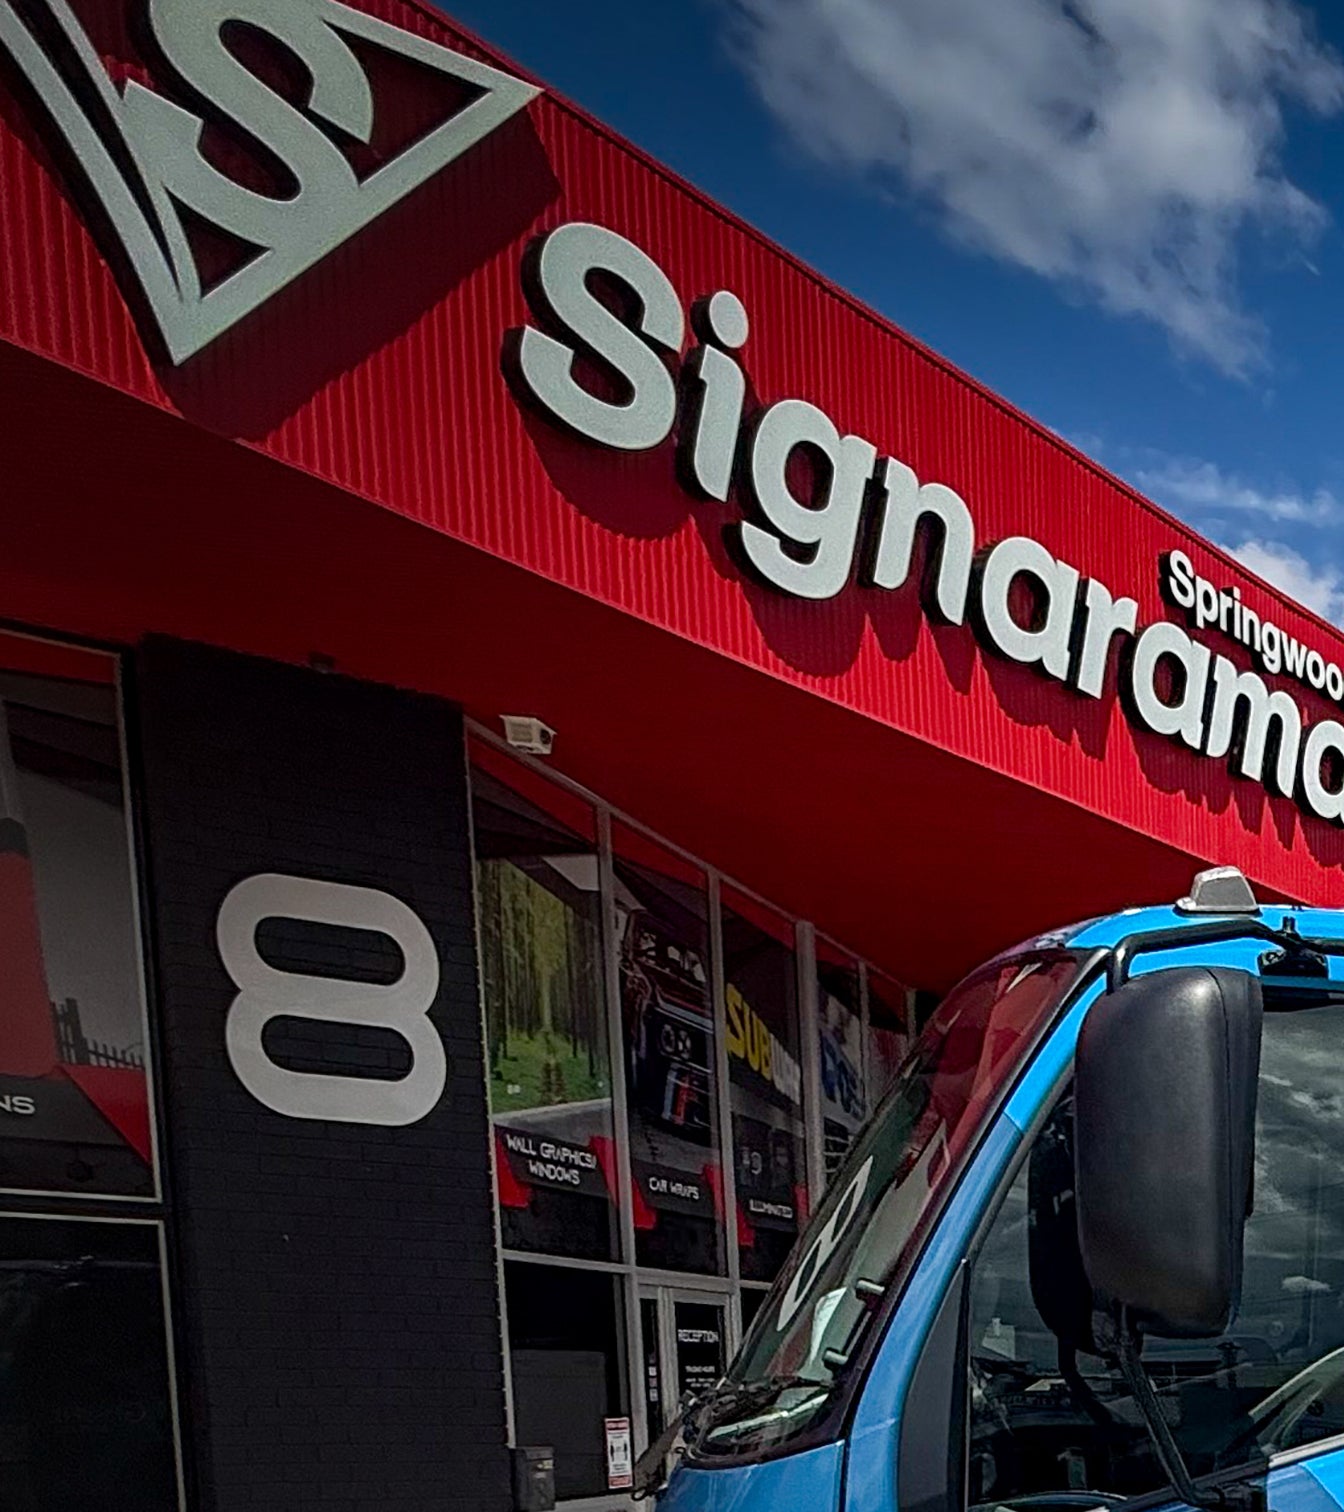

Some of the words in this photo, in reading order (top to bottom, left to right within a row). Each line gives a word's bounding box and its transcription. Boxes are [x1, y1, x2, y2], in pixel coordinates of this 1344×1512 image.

[217, 872, 447, 1126] 8
[506, 1134, 537, 1155] WALL
[528, 1160, 580, 1185] WINDOWS
[649, 1177, 667, 1192] CAR
